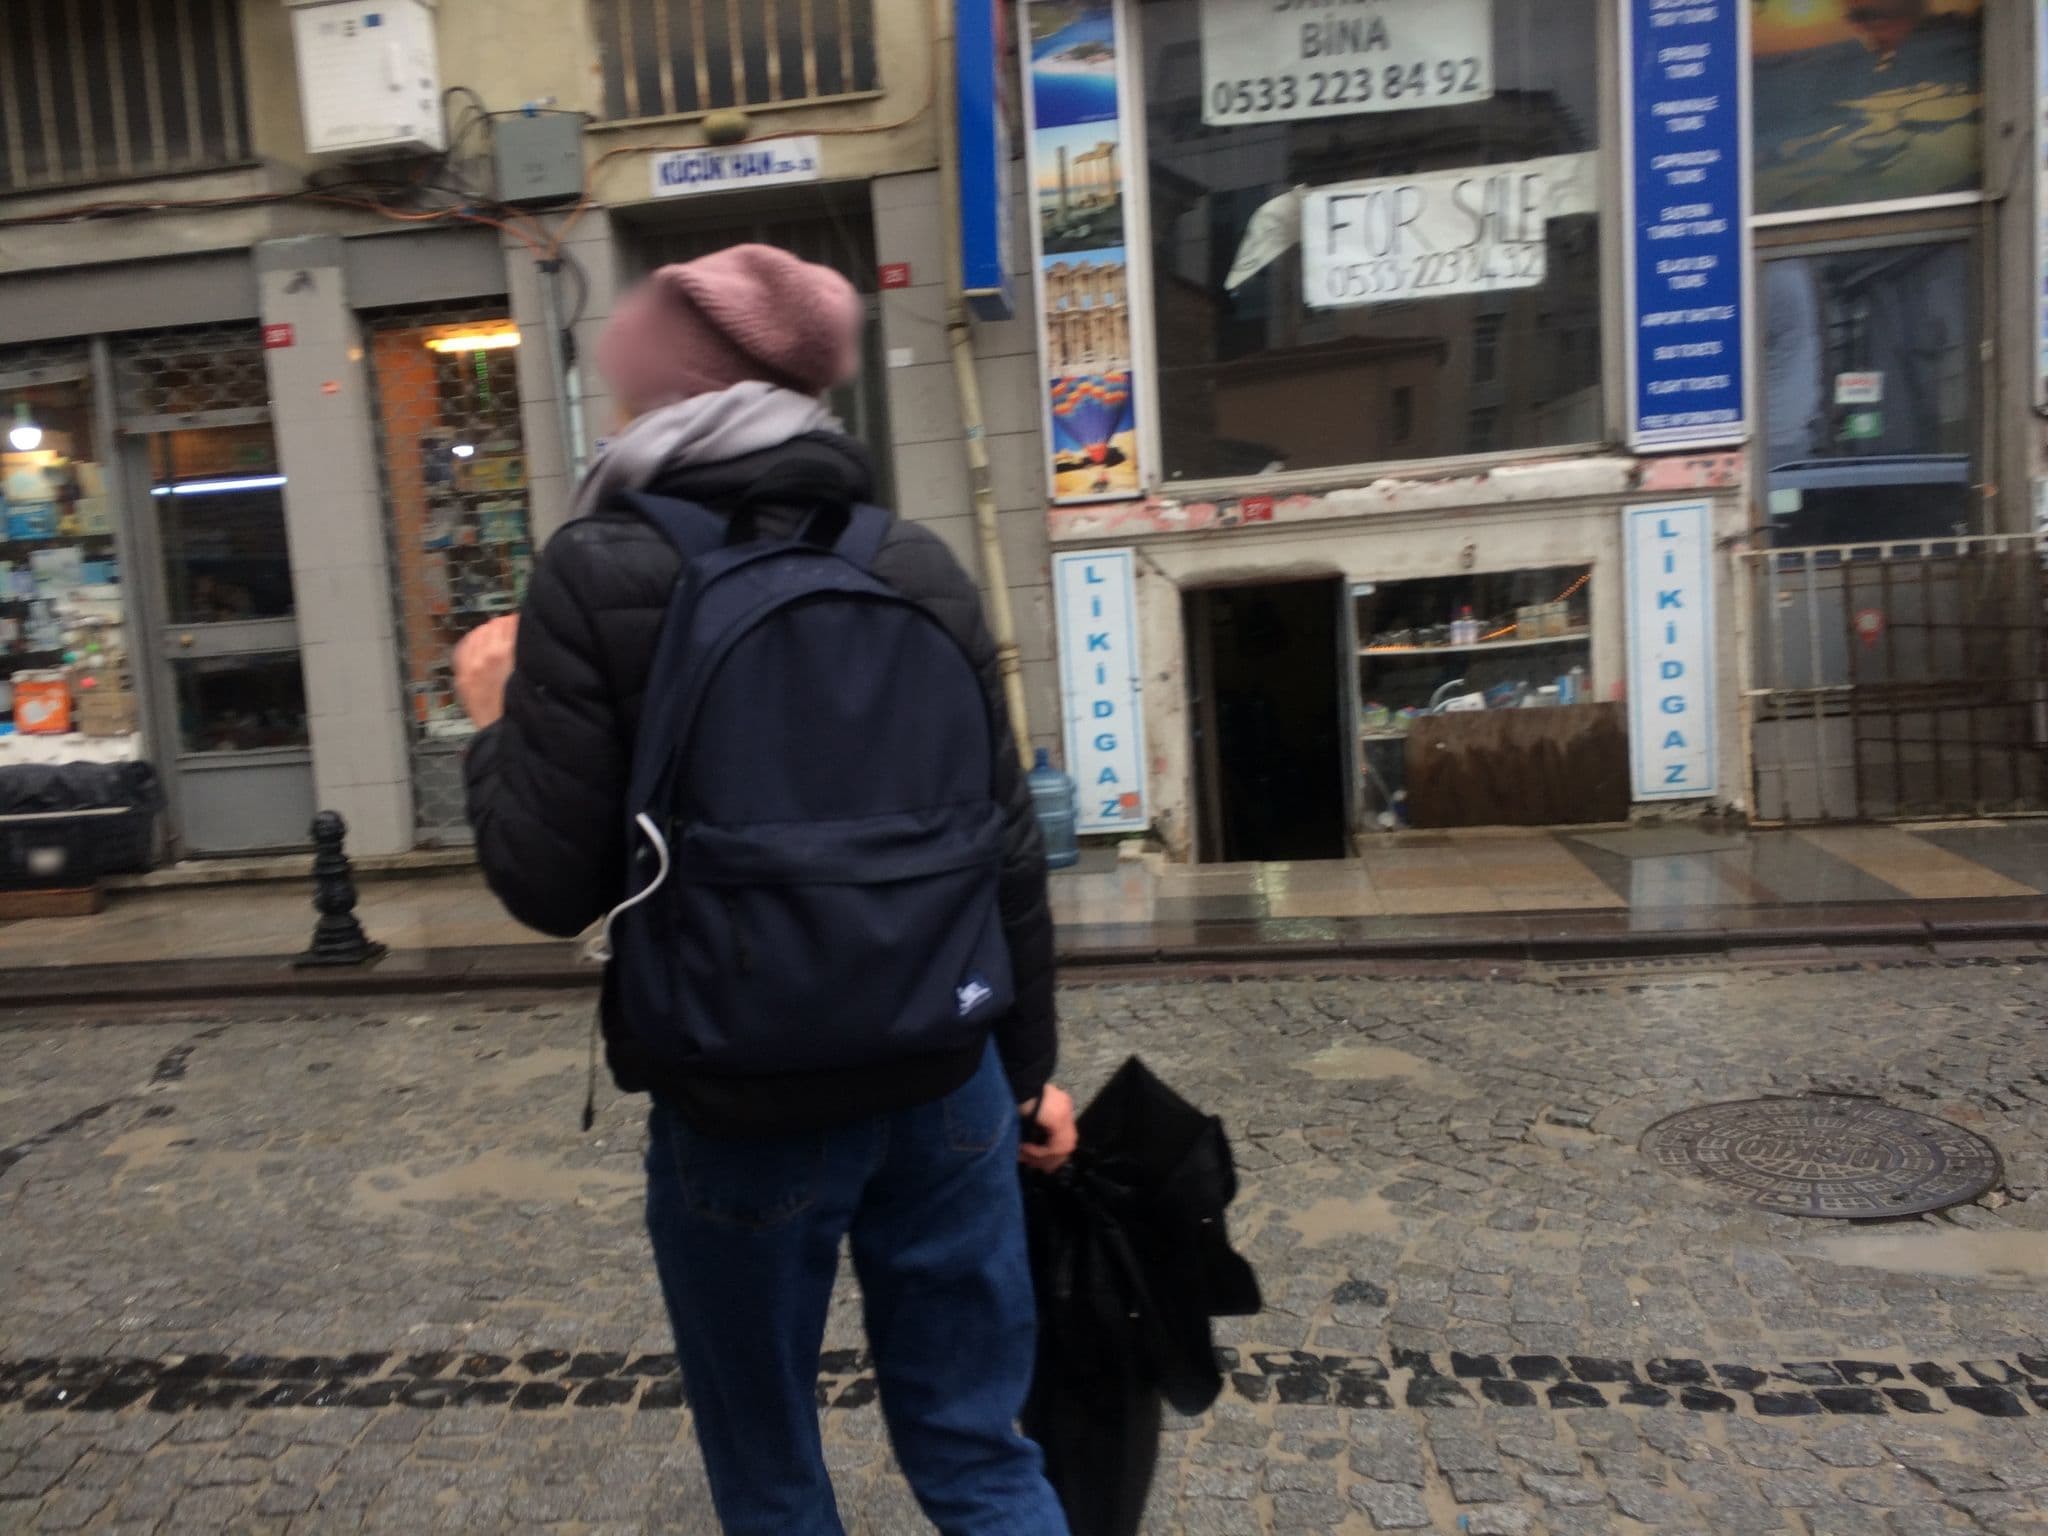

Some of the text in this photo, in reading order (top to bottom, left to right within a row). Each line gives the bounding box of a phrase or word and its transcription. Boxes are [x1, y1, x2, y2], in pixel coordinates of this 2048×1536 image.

[1300, 13, 1391, 59] BİNA
[1211, 56, 1481, 114] 0533 223 84 92
[1326, 186, 1437, 257] FOR
